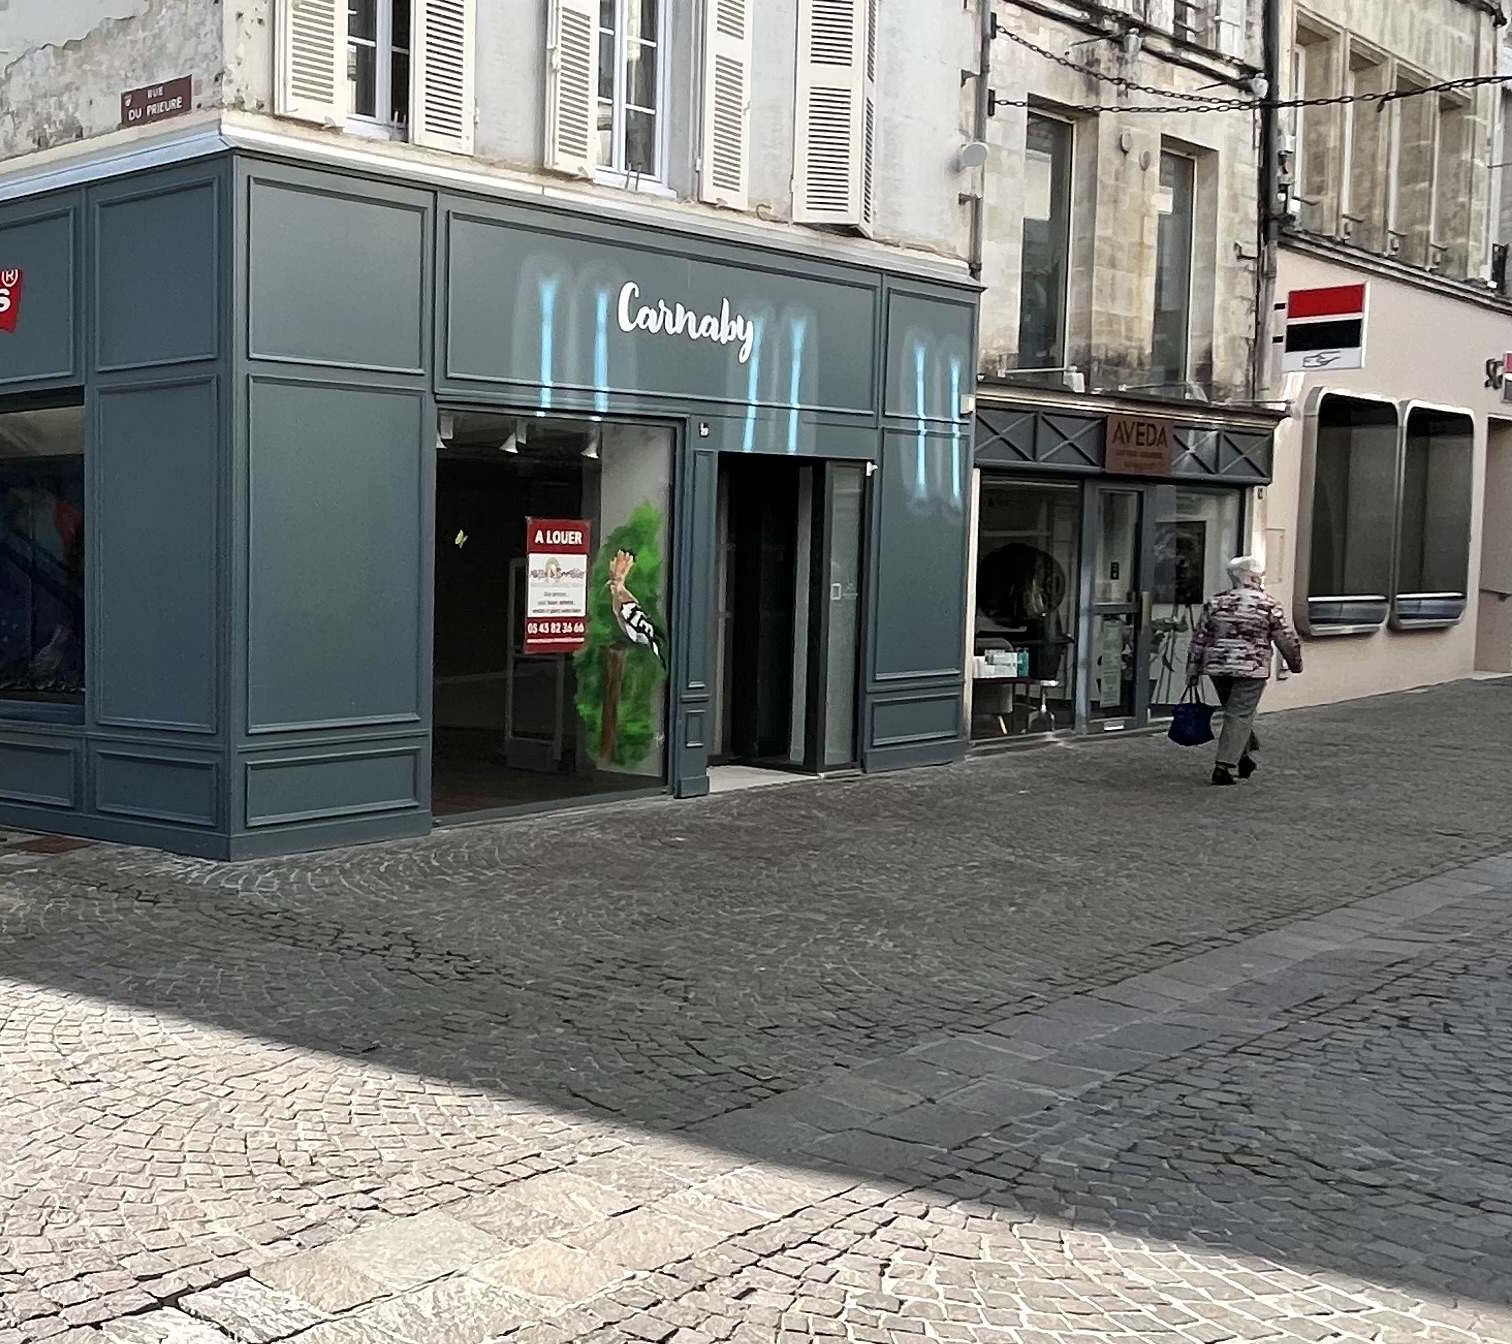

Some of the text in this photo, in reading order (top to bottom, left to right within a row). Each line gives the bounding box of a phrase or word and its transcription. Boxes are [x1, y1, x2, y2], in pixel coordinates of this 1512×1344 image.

[147, 86, 164, 98] RUE
[128, 107, 142, 121] DU
[618, 281, 754, 363] Carnaby
[1111, 420, 1169, 448] AVEDA
[534, 529, 583, 545] A LOUER
[528, 622, 538, 634] 05
